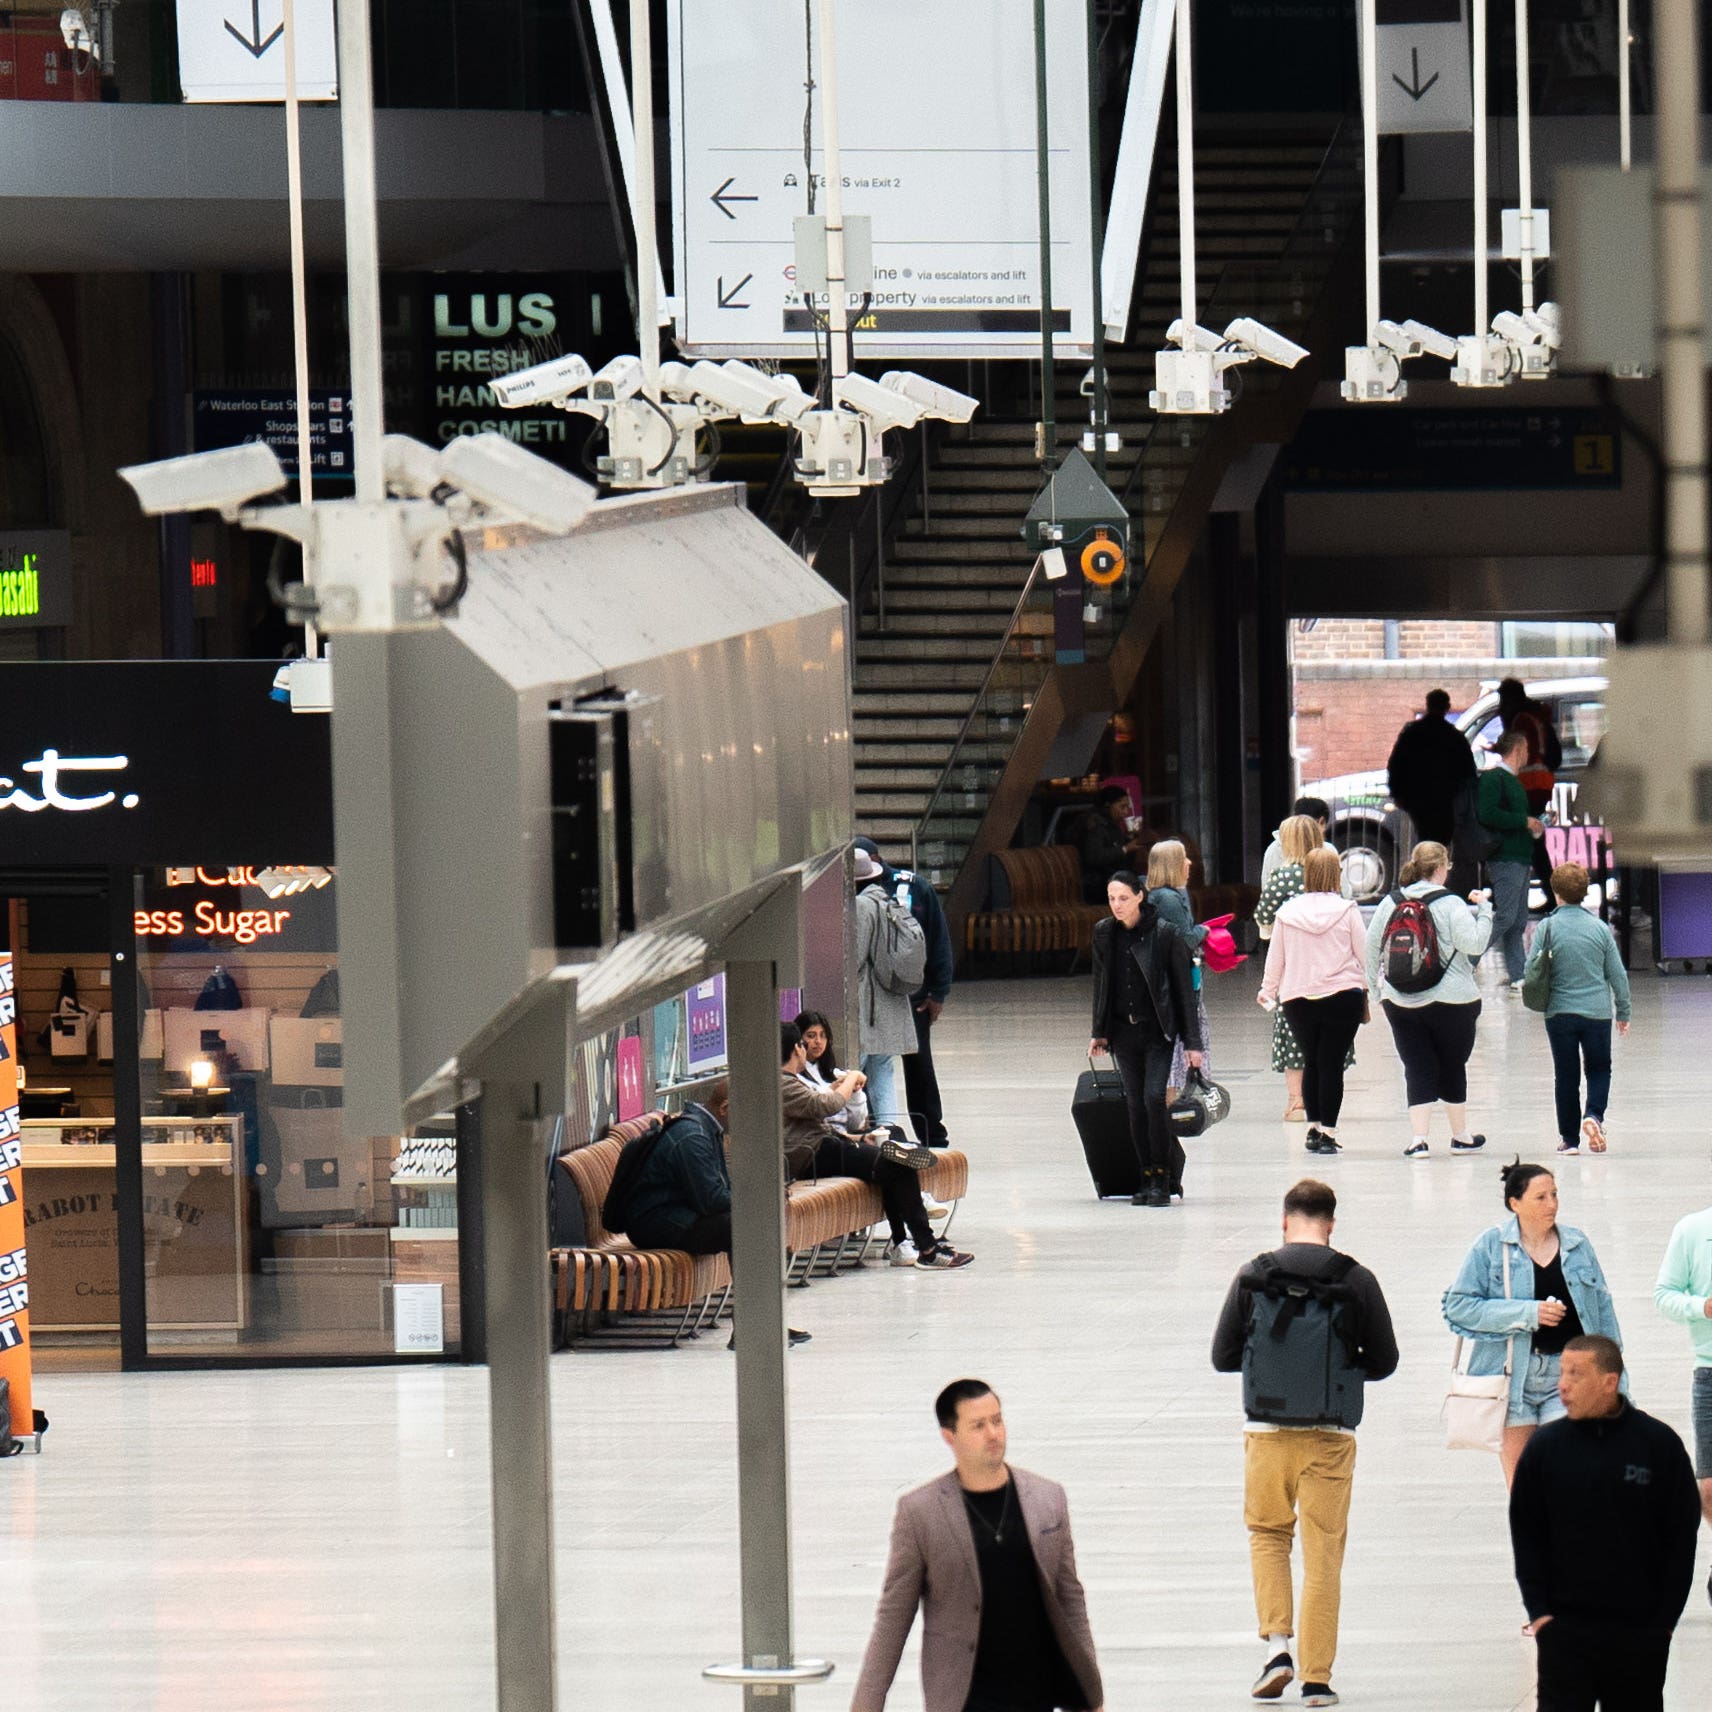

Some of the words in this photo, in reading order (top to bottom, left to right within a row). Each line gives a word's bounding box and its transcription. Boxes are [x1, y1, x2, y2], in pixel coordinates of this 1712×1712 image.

[872, 177, 890, 188] Exit
[918, 270, 932, 280] via
[934, 268, 987, 281] escalators
[990, 268, 1010, 281] and
[1012, 268, 1027, 281] lift
[922, 295, 938, 305] via
[938, 293, 992, 305] escalators
[995, 293, 1014, 305] and
[1016, 293, 1031, 305] lift
[436, 349, 530, 373] FRESH
[210, 400, 258, 411] Waterloo
[261, 400, 283, 411] East
[134, 911, 184, 935] ess
[194, 900, 291, 943] Sugar
